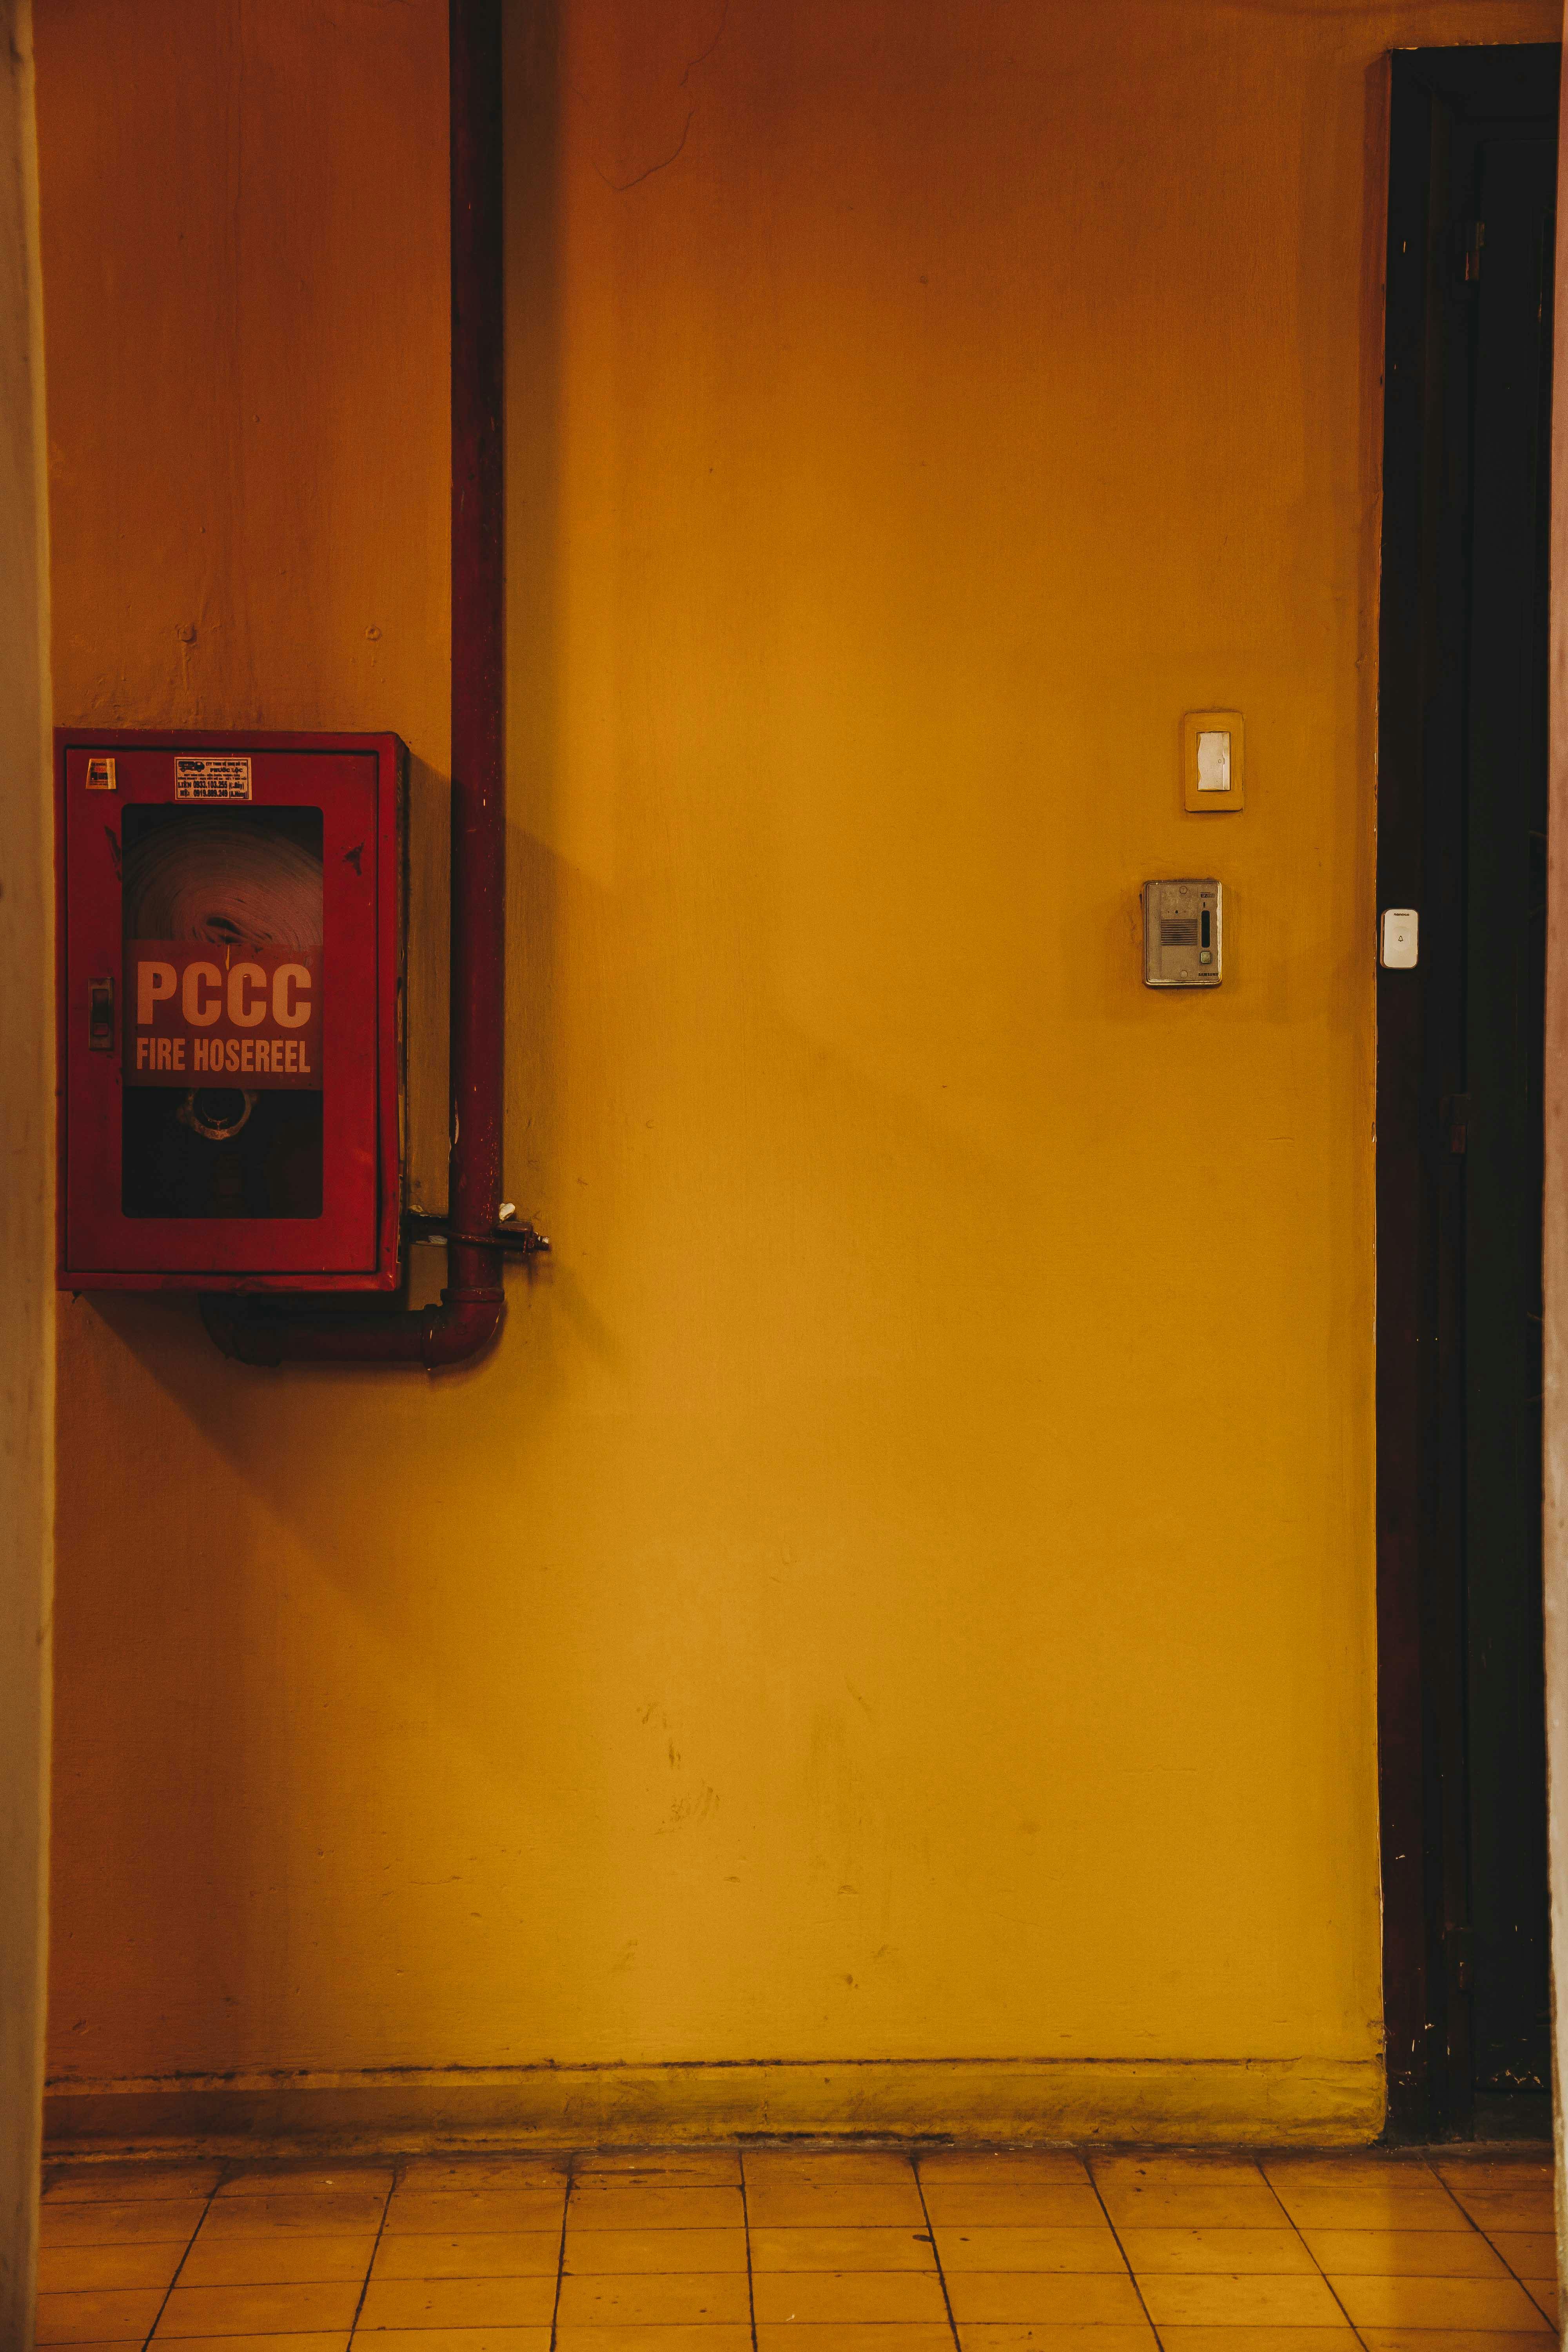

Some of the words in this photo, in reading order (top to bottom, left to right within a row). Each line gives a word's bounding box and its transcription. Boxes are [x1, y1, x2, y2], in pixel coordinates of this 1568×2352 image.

[137, 961, 311, 1028] PCCC
[136, 1038, 185, 1071] FIRE
[194, 1038, 310, 1073] HOSEREEL
